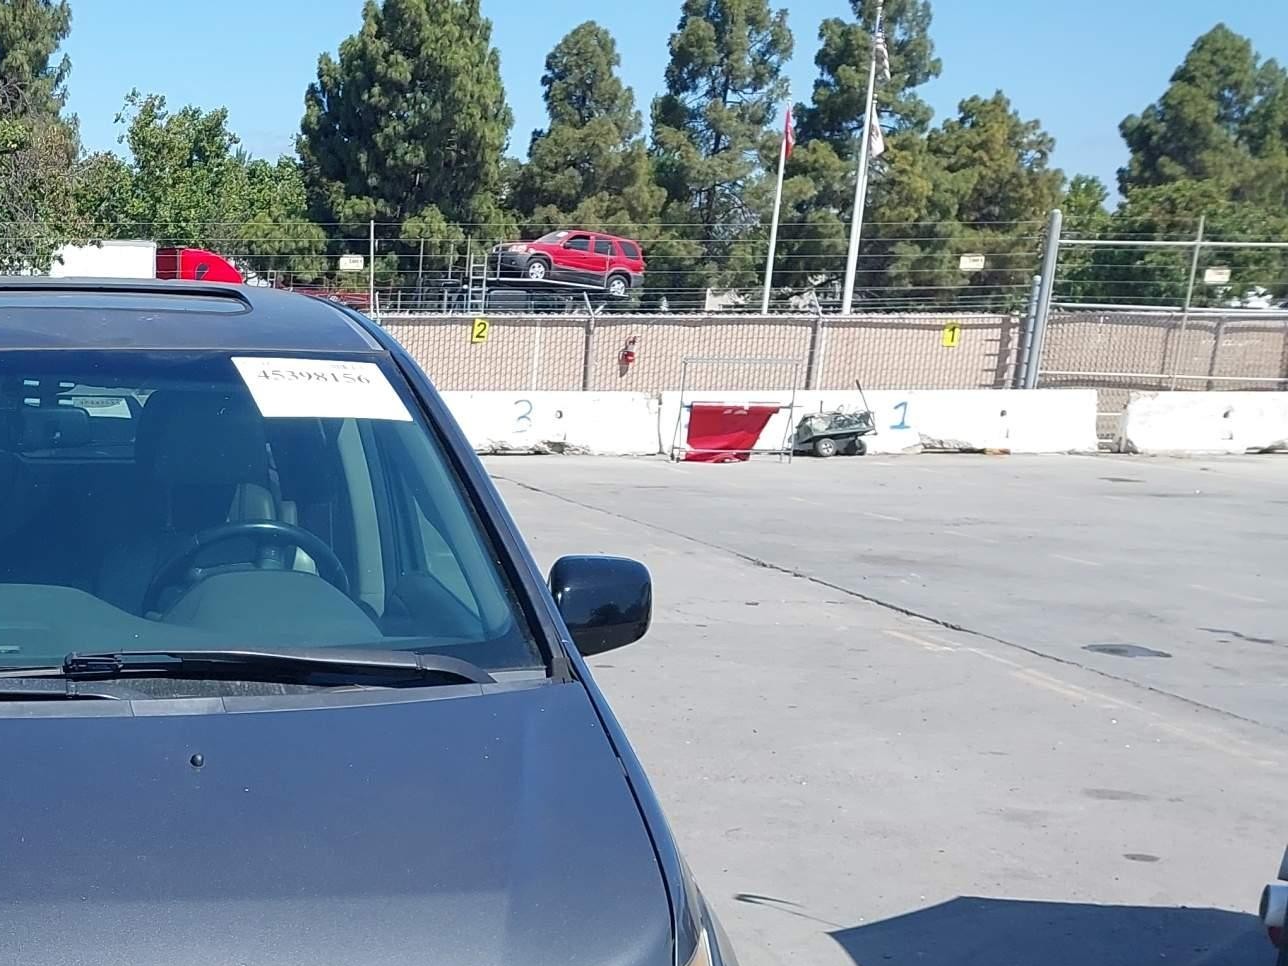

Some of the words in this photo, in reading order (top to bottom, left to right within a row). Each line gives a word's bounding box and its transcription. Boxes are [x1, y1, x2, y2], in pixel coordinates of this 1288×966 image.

[475, 321, 487, 339] 2
[948, 325, 956, 343] 1
[256, 368, 372, 385] 45398156
[889, 401, 911, 430] 1
